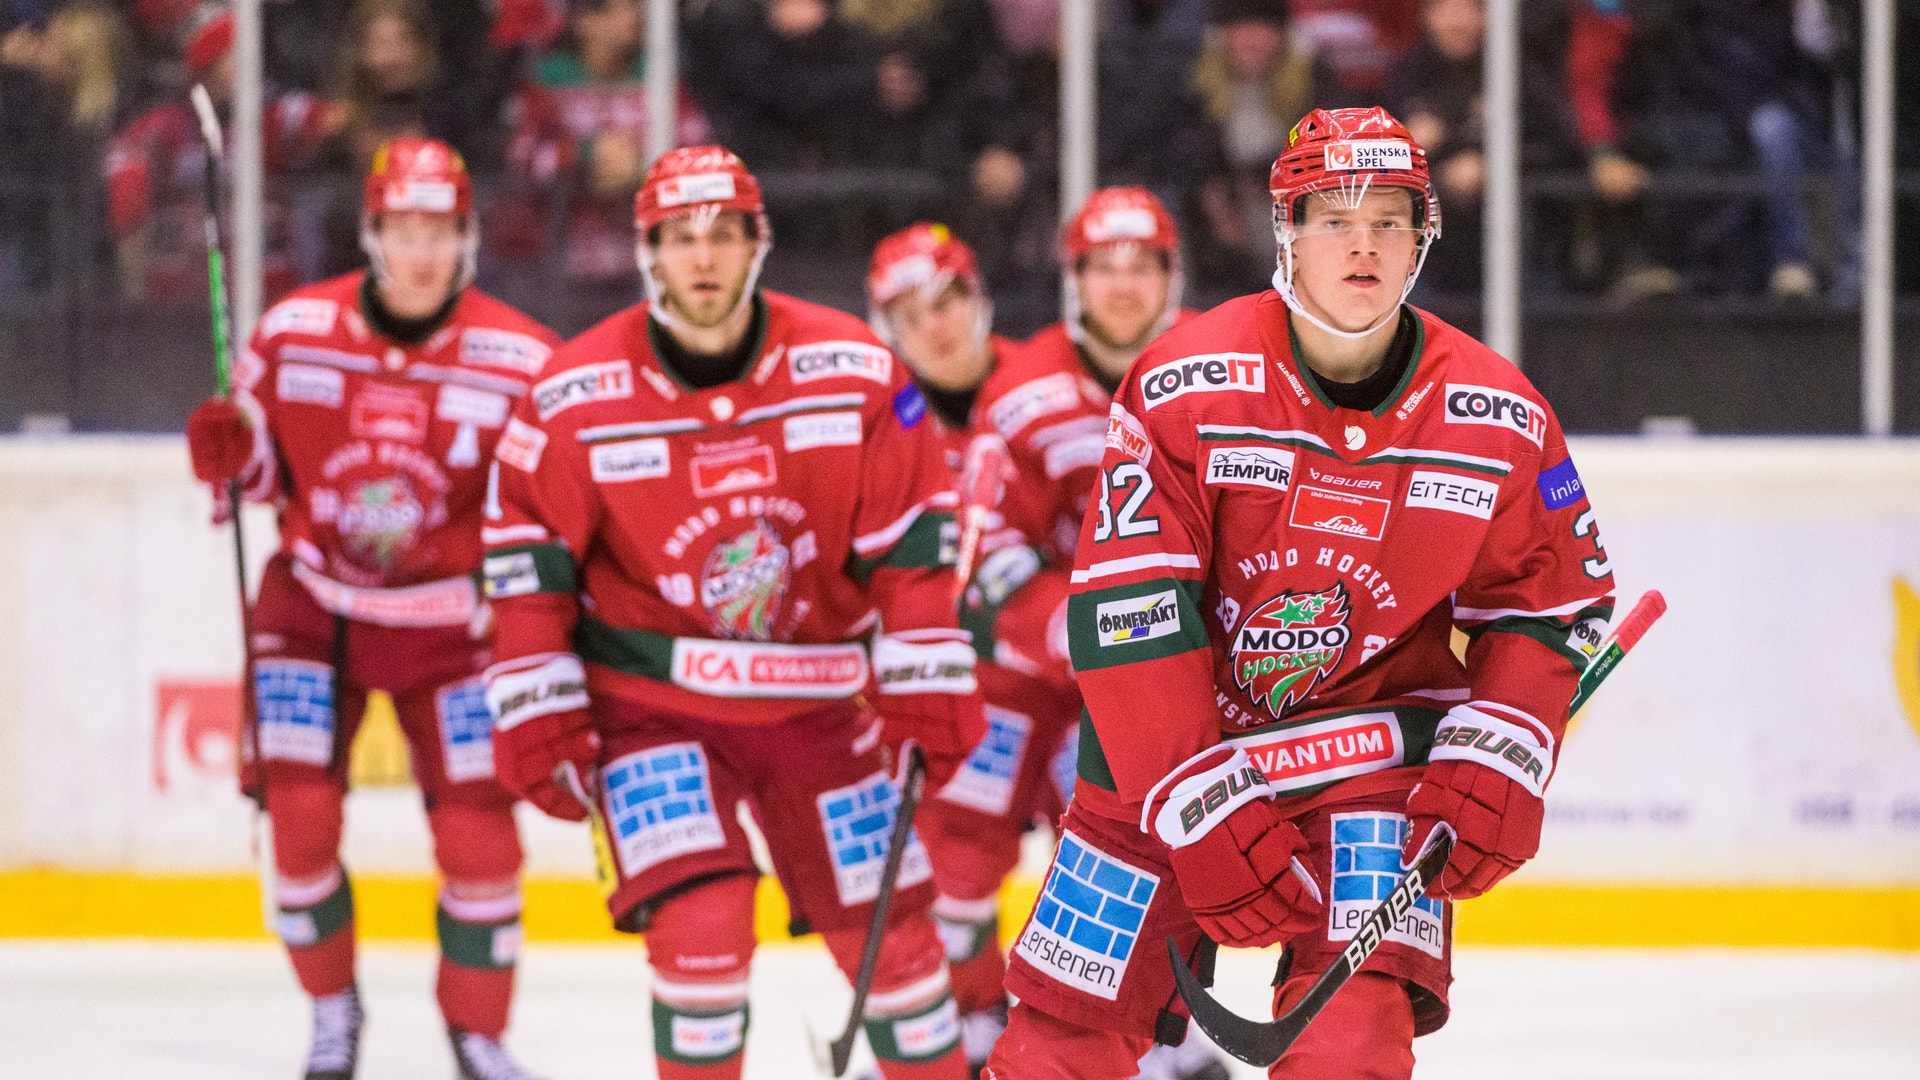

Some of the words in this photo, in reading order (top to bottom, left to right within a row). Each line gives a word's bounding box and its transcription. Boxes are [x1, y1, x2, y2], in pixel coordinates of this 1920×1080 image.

[1356, 147, 1409, 158] SVENSKA
[1357, 158, 1386, 167] SPEL
[1212, 464, 1290, 486] TEMPUR
[1313, 515, 1368, 535] Linde
[1237, 548, 1298, 580] MODO
[1316, 547, 1398, 610] HOCKEY
[1099, 603, 1177, 634] ÖRNFRAKT
[1241, 626, 1345, 651] MODO
[683, 651, 740, 684] ICA
[1242, 648, 1335, 682] HOCKEY
[1249, 729, 1385, 774] VANTUM
